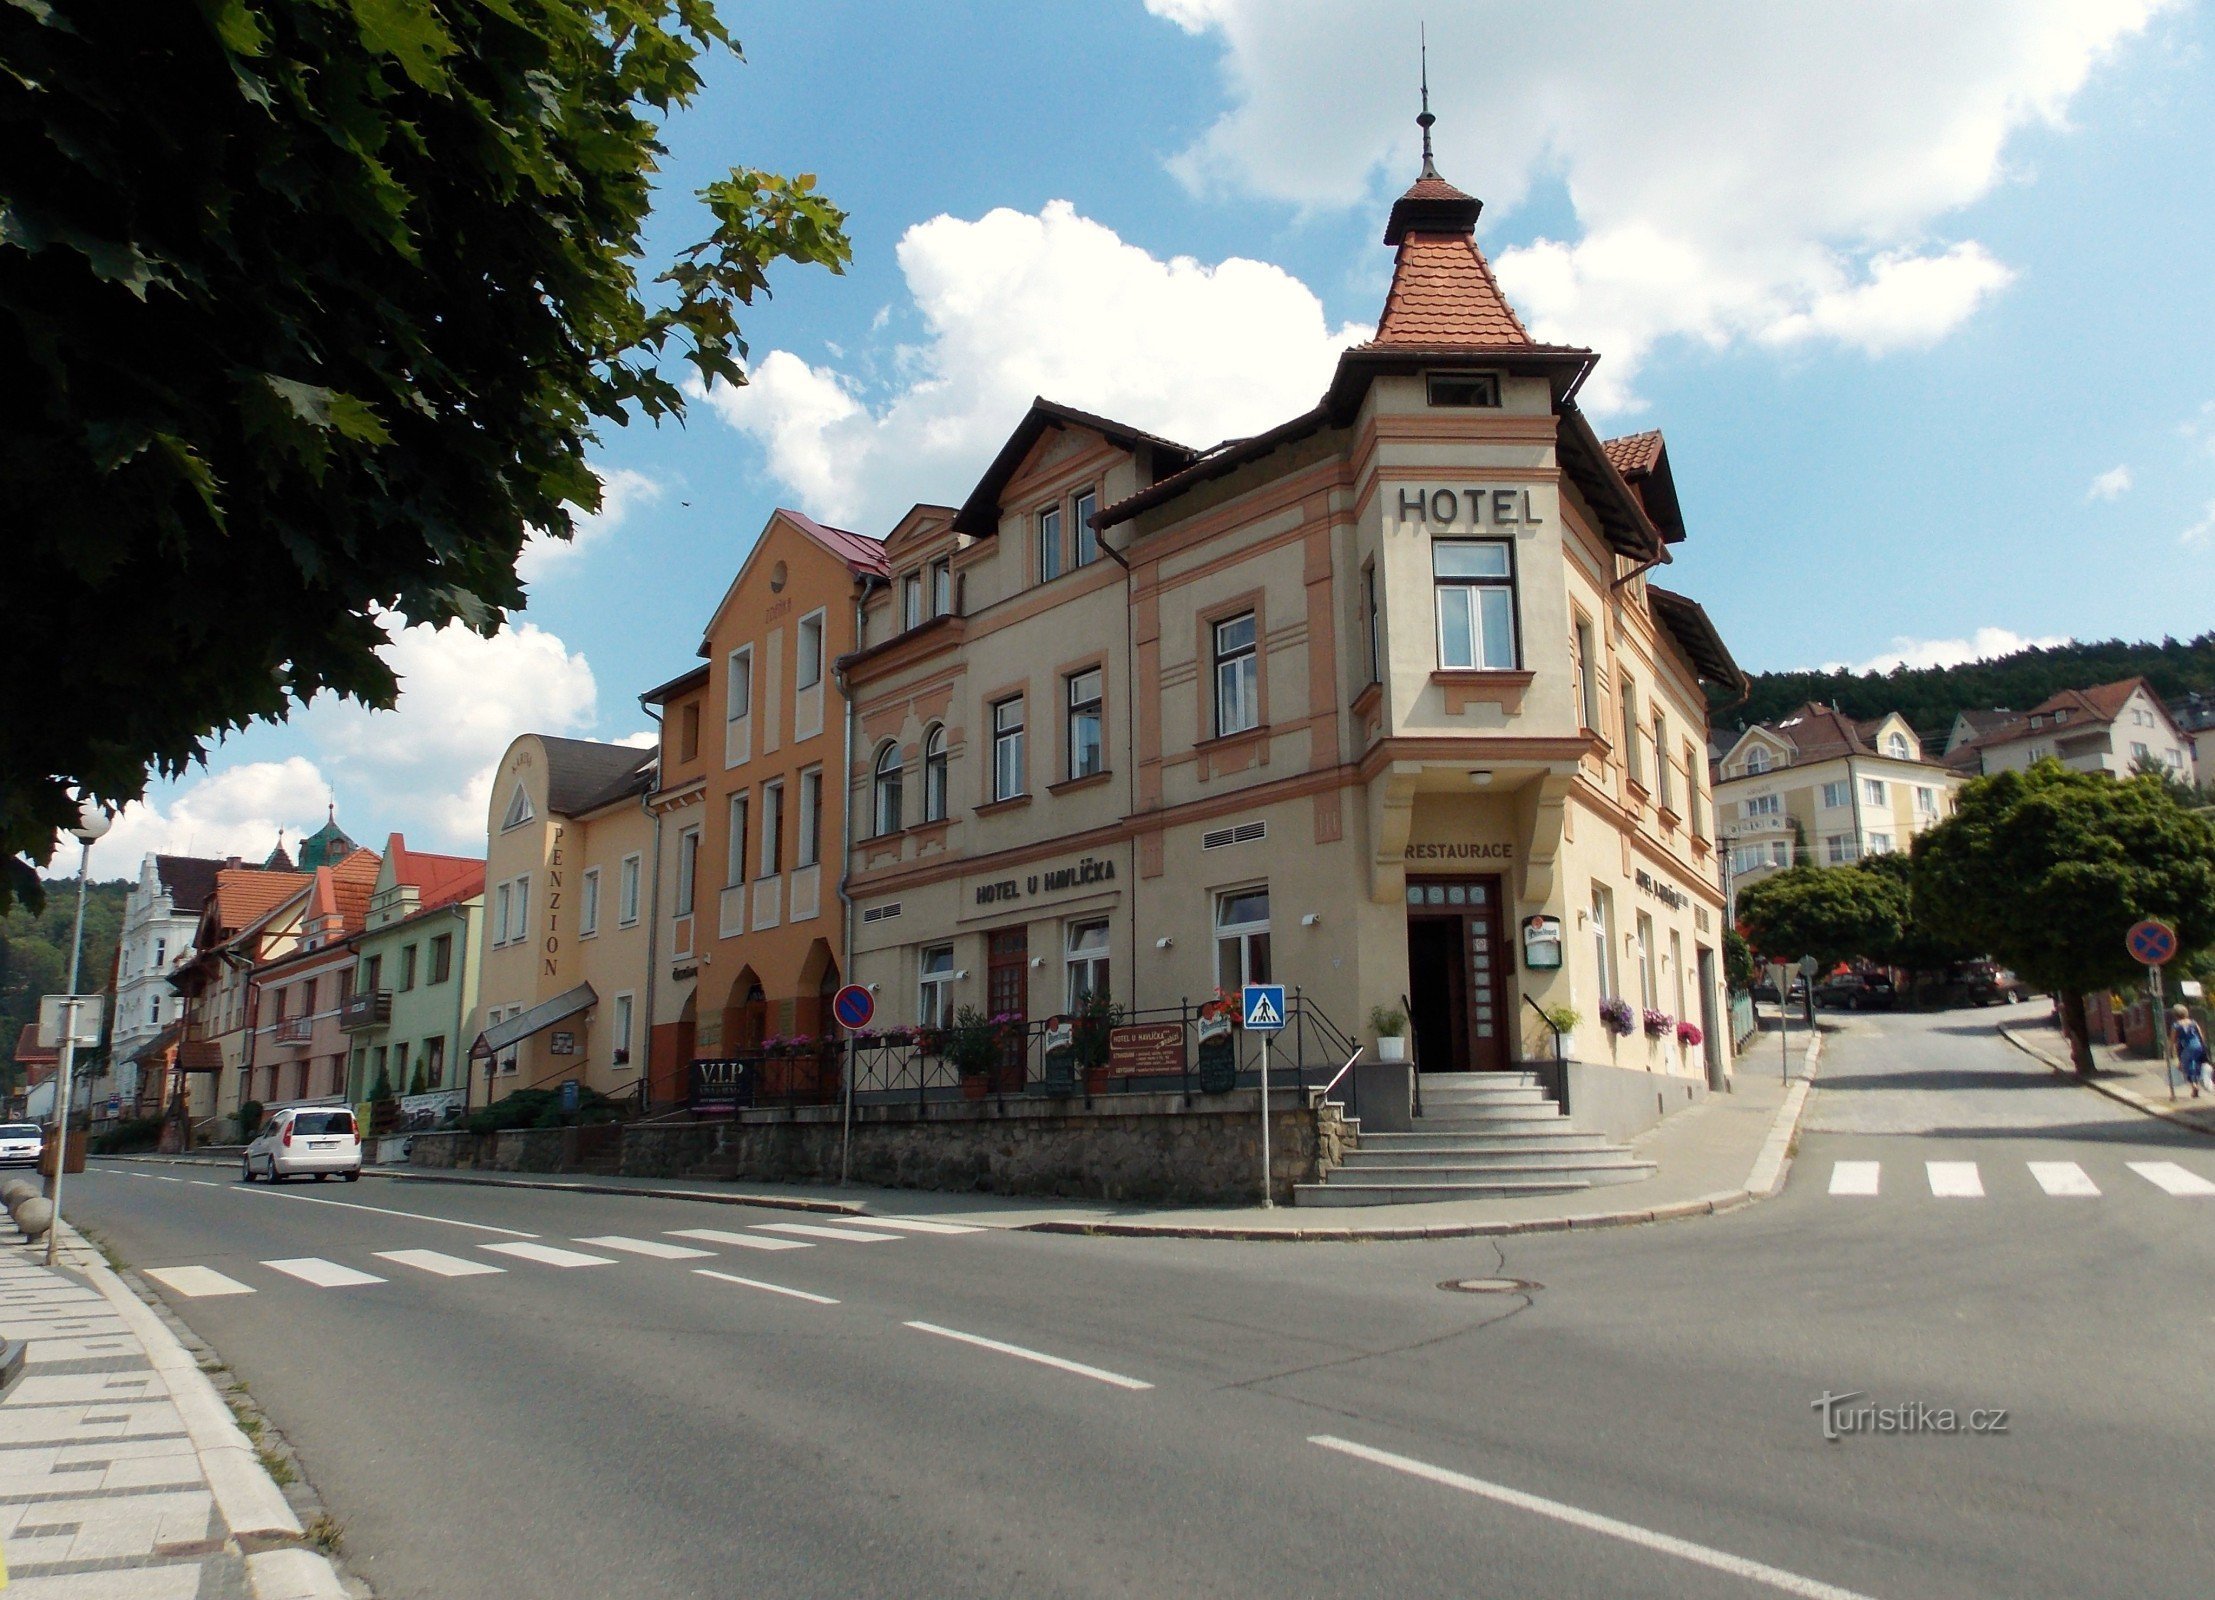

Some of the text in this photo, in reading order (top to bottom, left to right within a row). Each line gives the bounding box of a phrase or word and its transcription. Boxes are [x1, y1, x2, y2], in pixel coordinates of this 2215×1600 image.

[1399, 488, 1543, 524] HOTEL
[1404, 843, 1513, 859] RESTAURACE
[544, 827, 563, 976] PENZION
[976, 879, 1020, 904] HOTEL
[1027, 875, 1037, 895] U
